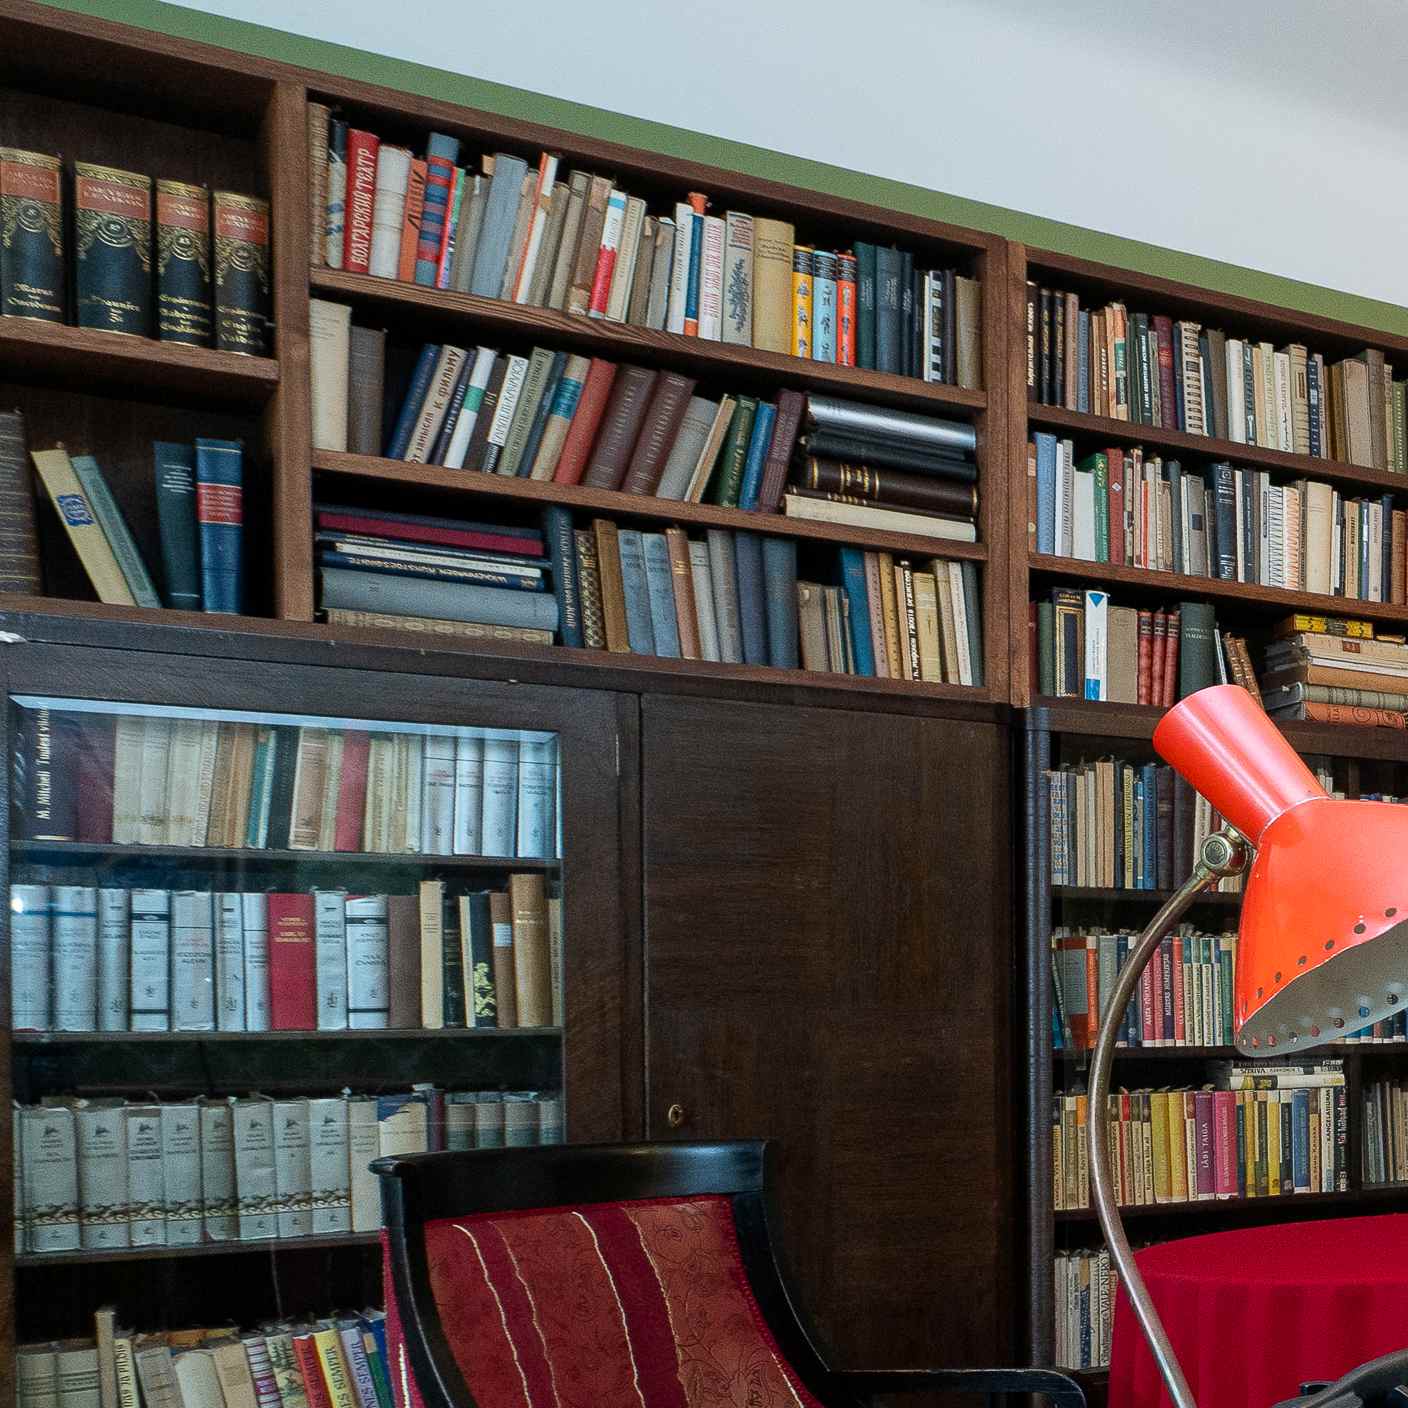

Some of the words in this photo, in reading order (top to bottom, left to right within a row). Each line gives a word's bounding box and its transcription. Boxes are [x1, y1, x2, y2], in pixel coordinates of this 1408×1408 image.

[354, 148, 375, 190] ТЕАТР
[349, 192, 372, 265] БОЛГАРСКИЙ
[437, 350, 460, 397] ФИЛЬМУ
[36, 771, 50, 805] Mitchell
[326, 1345, 347, 1390] SEMPER
[351, 1341, 372, 1384] SEMPER
